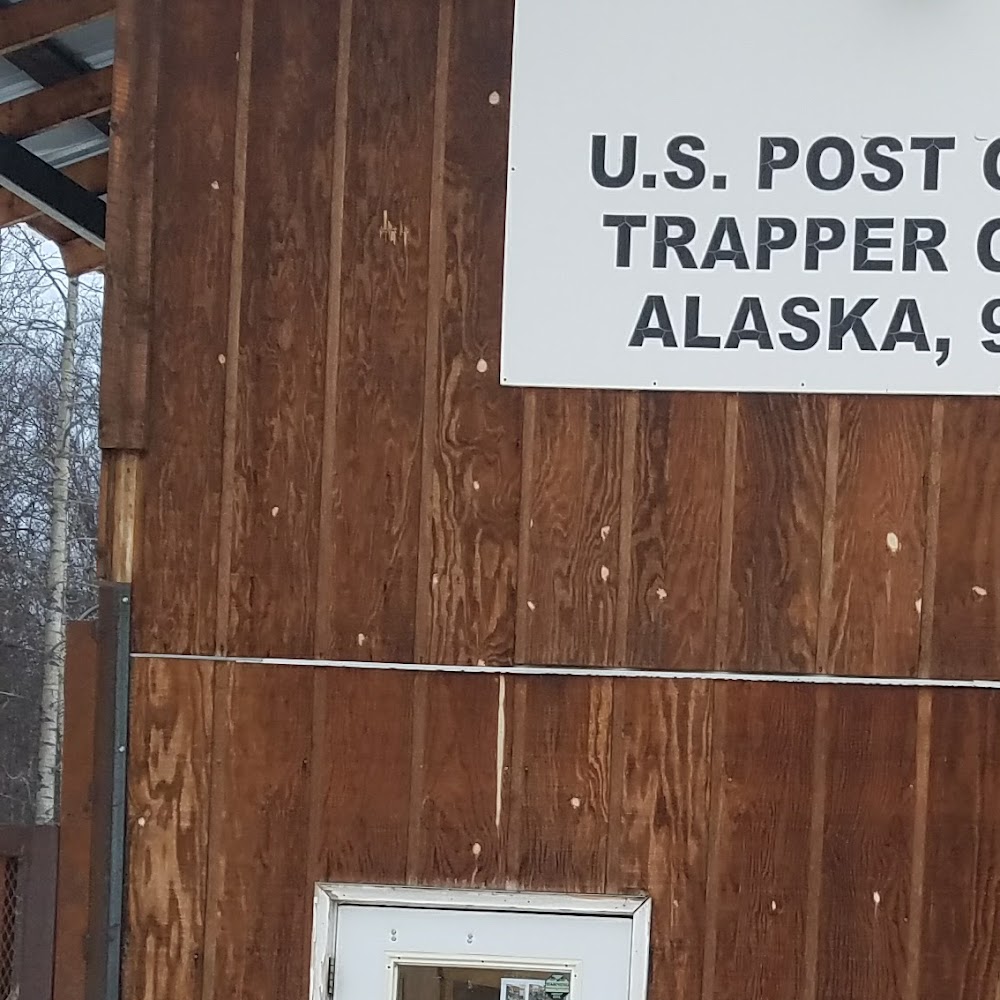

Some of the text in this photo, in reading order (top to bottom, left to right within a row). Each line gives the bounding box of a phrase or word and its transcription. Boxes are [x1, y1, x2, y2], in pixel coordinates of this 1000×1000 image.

[591, 134, 727, 190] U.S.
[758, 135, 956, 192] POST
[602, 214, 949, 272] TRAPPER
[628, 295, 950, 367] ALASKA,
